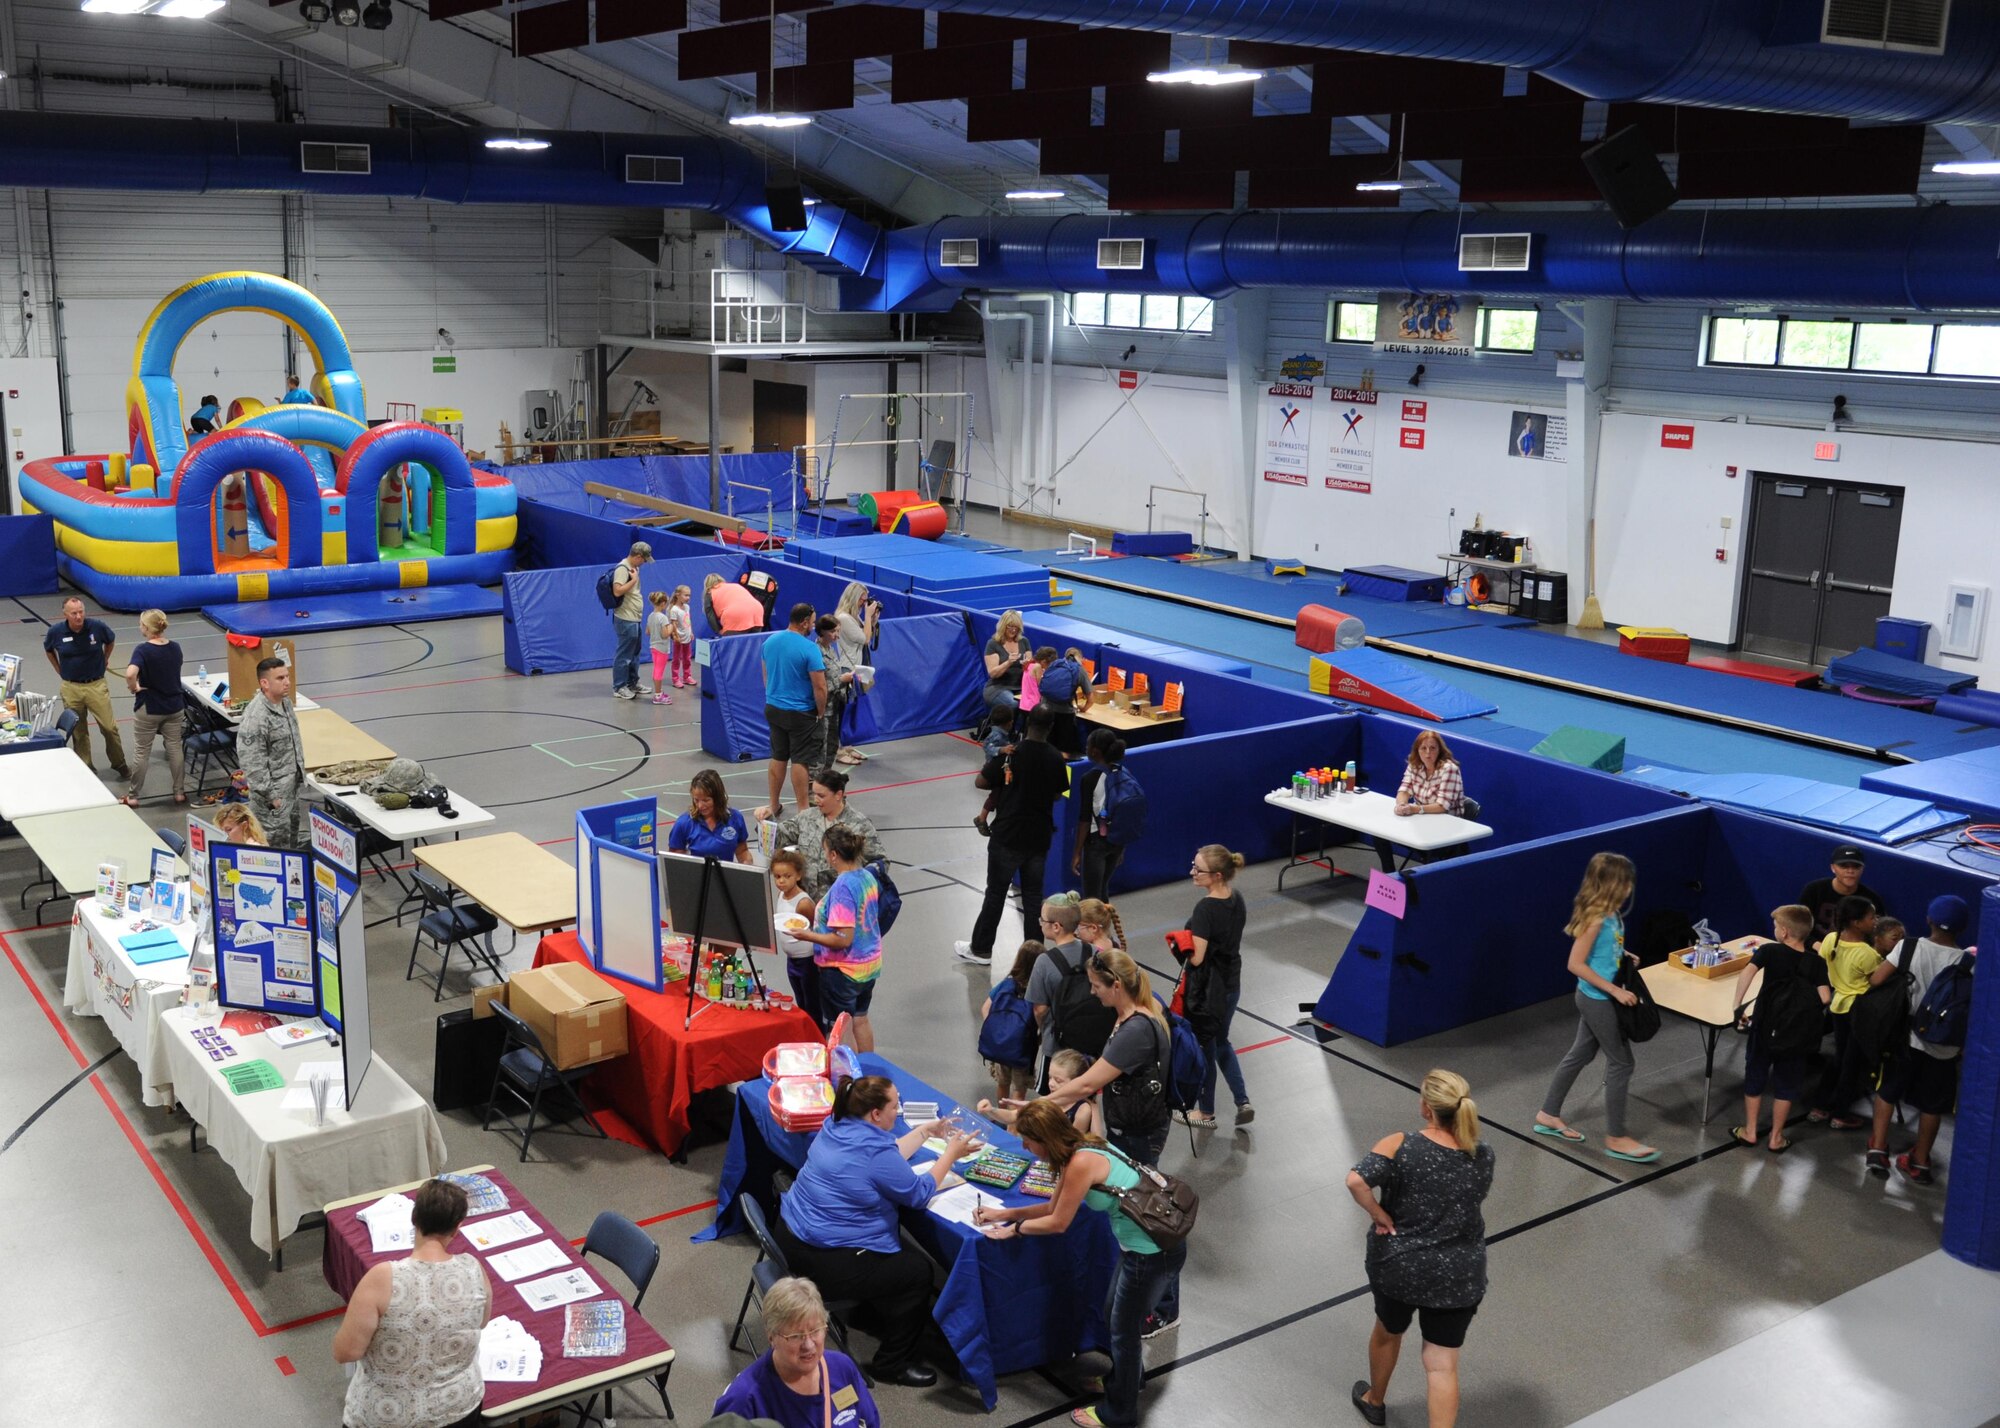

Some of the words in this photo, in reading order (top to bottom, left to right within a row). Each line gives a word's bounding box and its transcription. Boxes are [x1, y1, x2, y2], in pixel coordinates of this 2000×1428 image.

[1384, 344, 1411, 353] LEVEL
[1415, 345, 1420, 354] 3
[1423, 346, 1469, 356] 2014-2015
[1271, 384, 1312, 396] 2015-2016
[1334, 389, 1376, 402] 2014-2015
[1665, 432, 1690, 441] SHAPES
[1278, 442, 1308, 451] GYMNASTICS
[1340, 448, 1371, 458] GYMNASTICS
[1338, 685, 1370, 698] AMERICAN
[312, 816, 338, 841] SCHOOL
[318, 834, 344, 860] LIAISON
